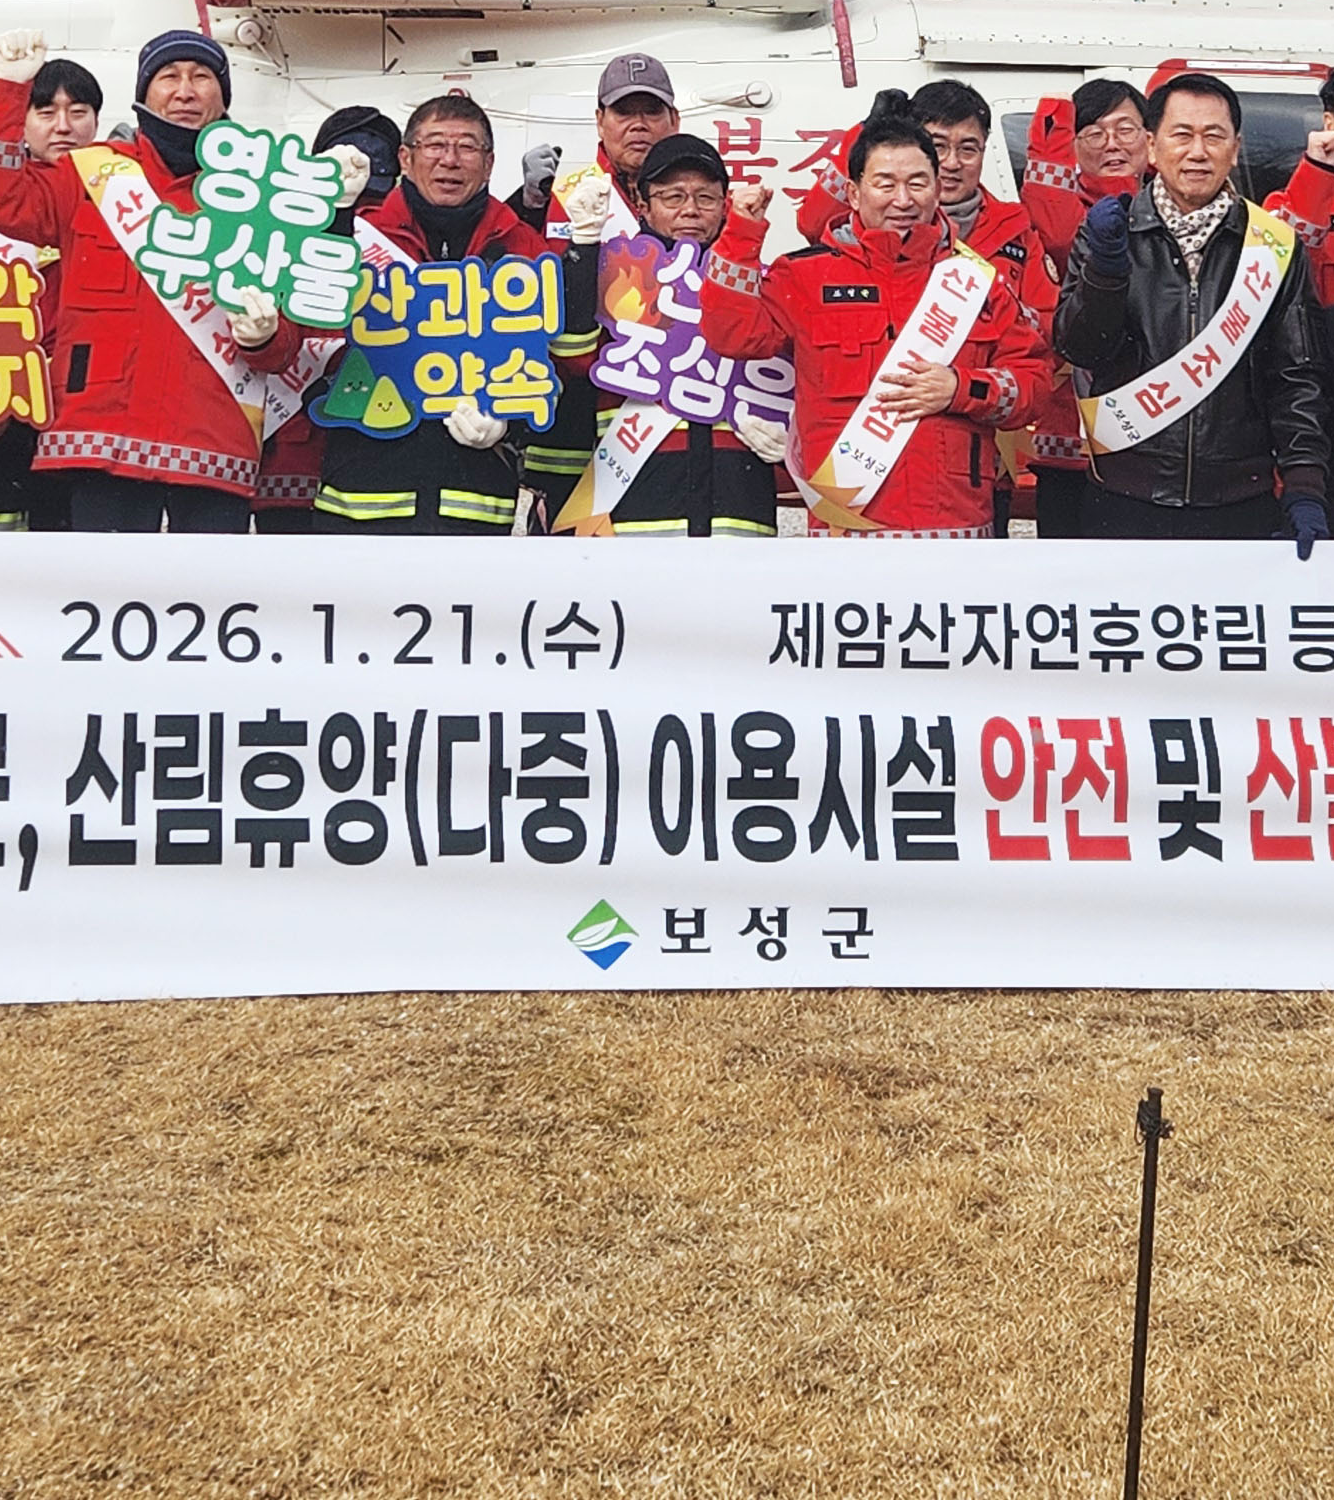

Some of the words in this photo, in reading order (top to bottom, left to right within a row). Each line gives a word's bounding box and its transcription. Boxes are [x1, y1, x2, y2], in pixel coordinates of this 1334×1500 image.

[629, 60, 646, 81] P
[199, 126, 341, 225] 영농
[140, 209, 360, 323] 부산물
[351, 258, 556, 346] 산과의
[1134, 260, 1273, 419] 산불조심
[414, 348, 556, 427] 약속
[62, 601, 283, 665] 2026.
[770, 602, 1267, 672] 제암산자연휴양림
[66, 708, 620, 868] 산림휴양(다중)
[649, 710, 960, 862] 이용시설
[981, 717, 1131, 861] 안전
[1150, 717, 1223, 862] 및
[660, 907, 874, 962] 보성군
